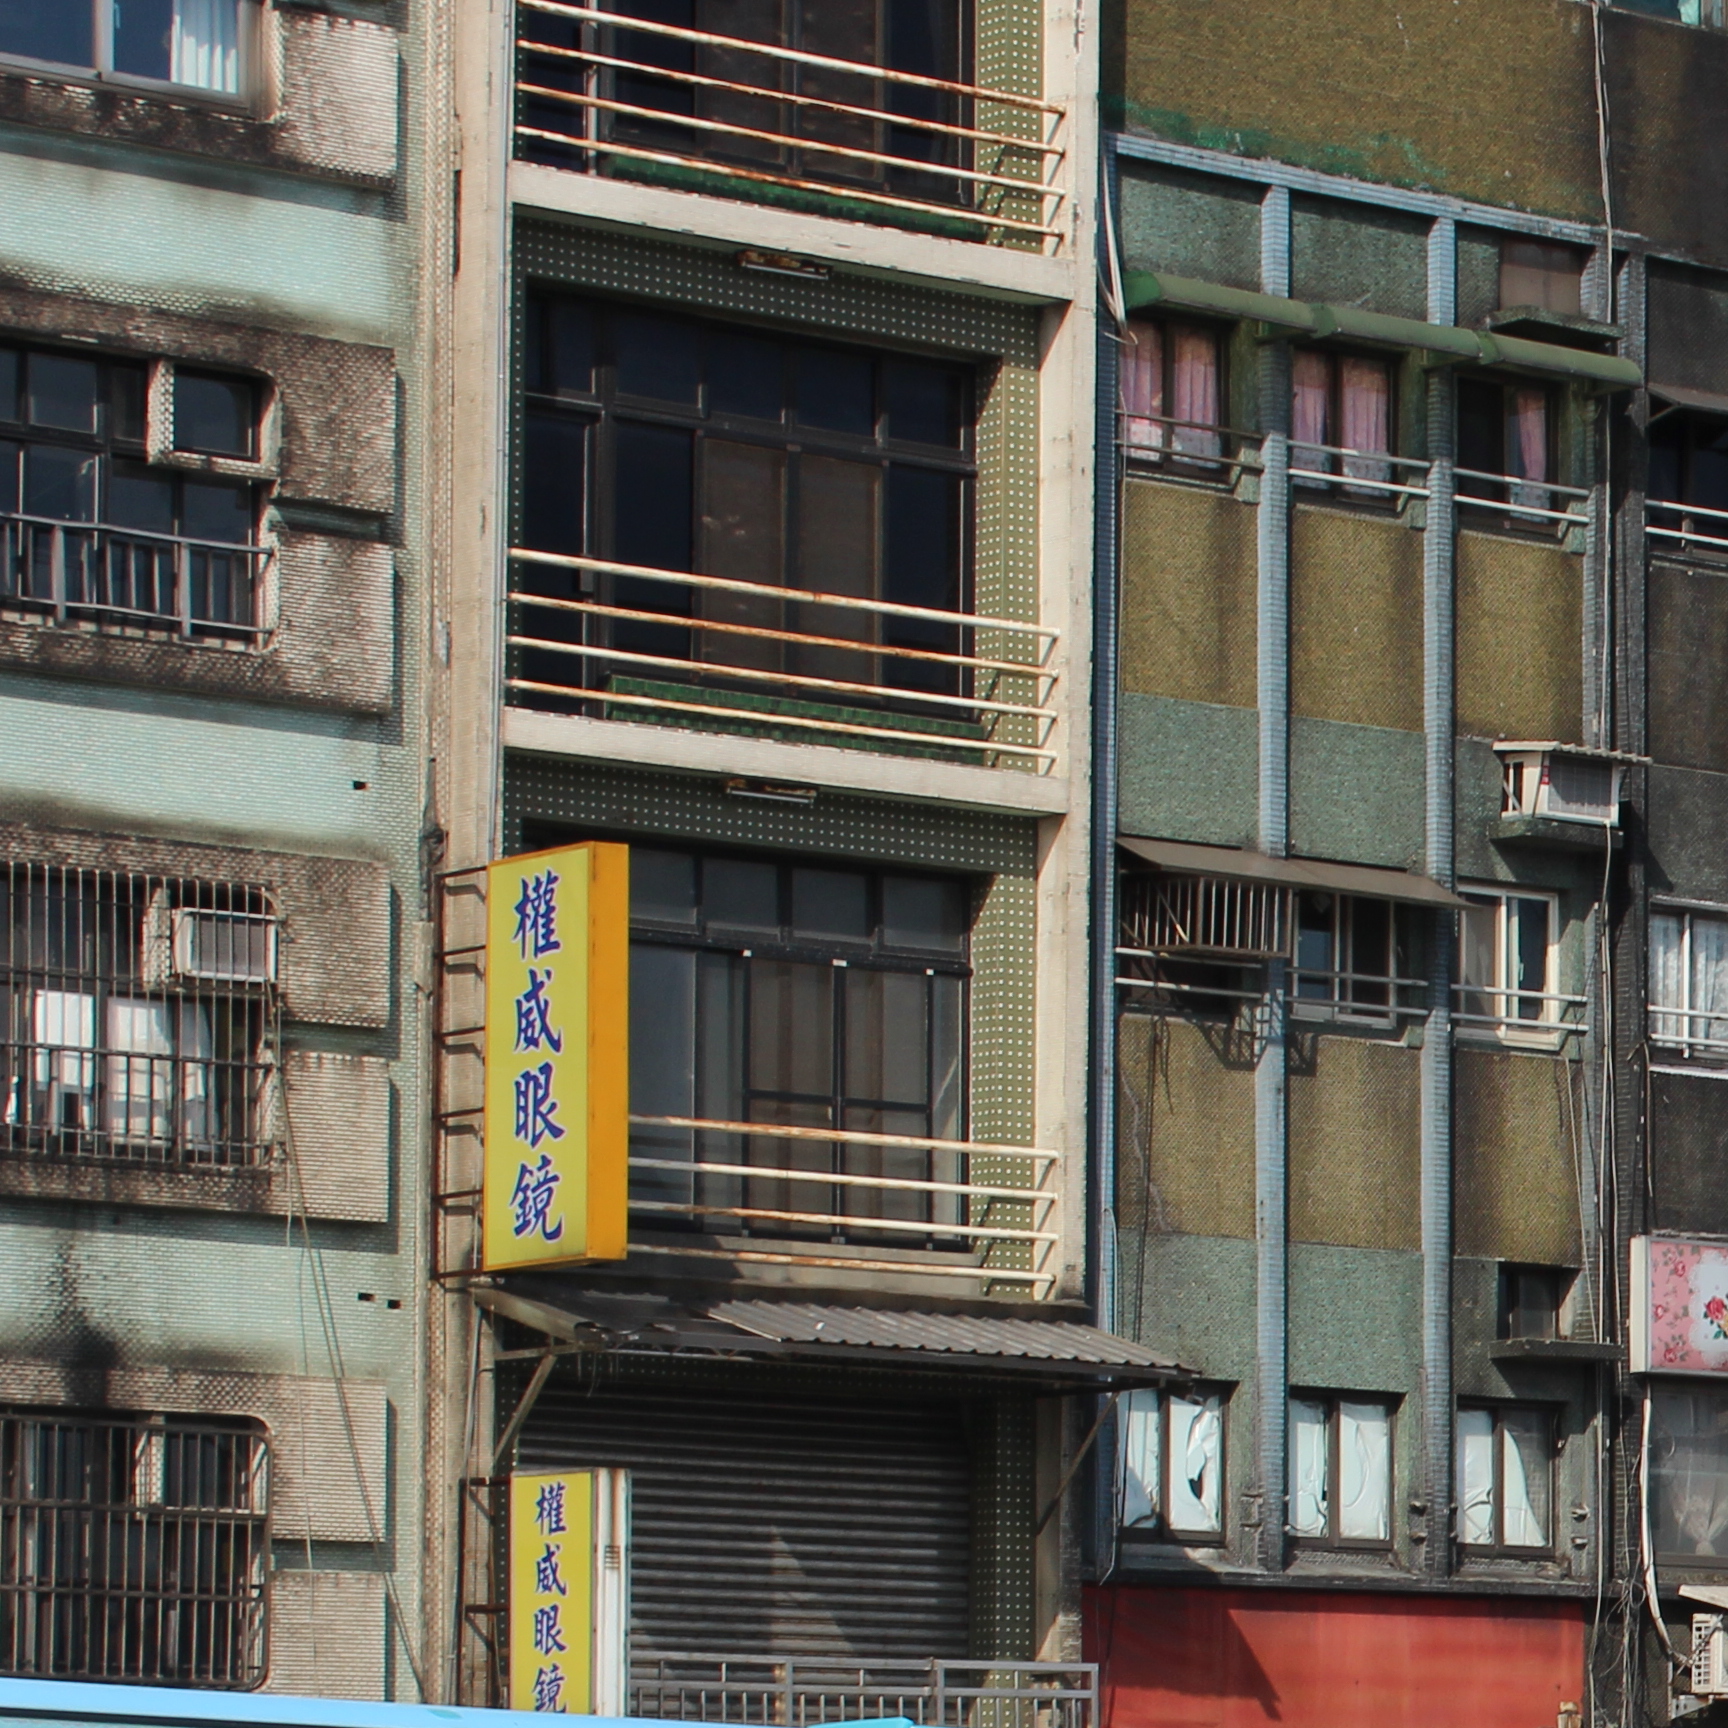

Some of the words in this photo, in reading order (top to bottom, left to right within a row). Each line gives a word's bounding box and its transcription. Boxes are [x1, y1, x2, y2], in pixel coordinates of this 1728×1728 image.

[508, 866, 565, 1244] 權威眼鏡
[530, 1480, 569, 1717] 權威眼鏡
